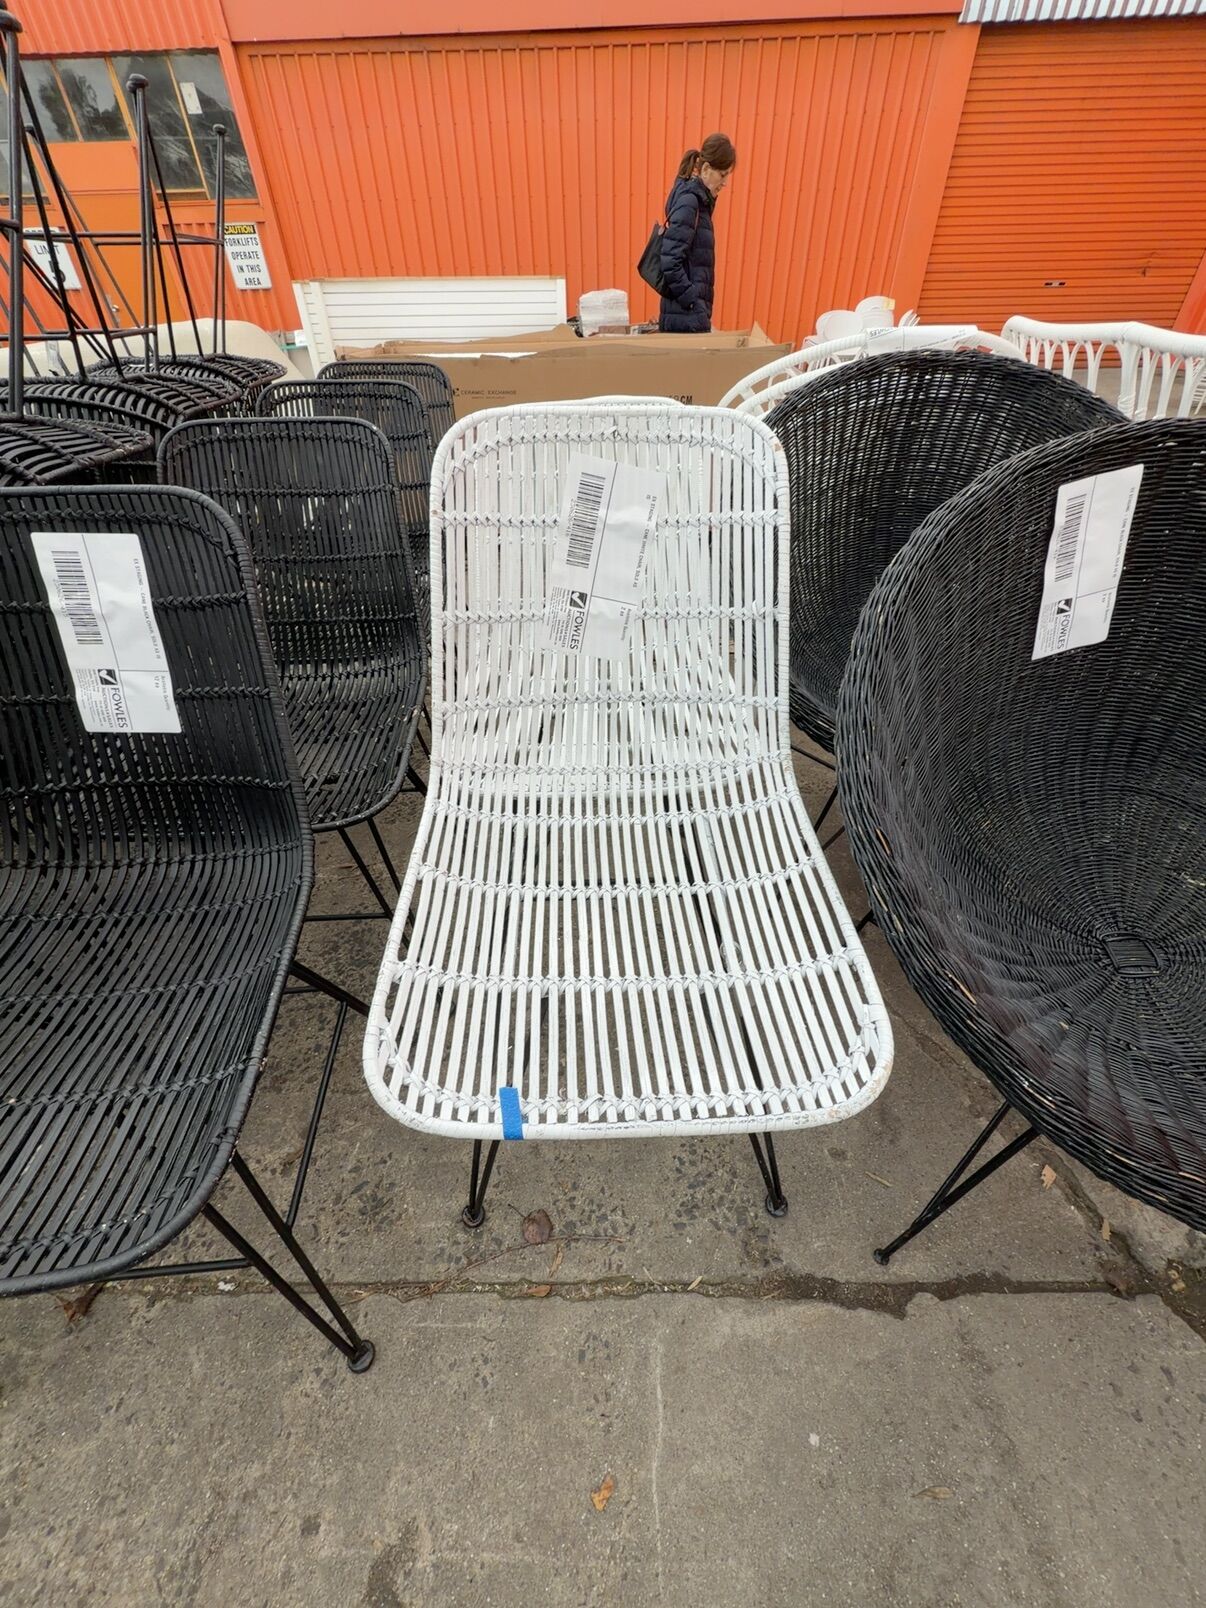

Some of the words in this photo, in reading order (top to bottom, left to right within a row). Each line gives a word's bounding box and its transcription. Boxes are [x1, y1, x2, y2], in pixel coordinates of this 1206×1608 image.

[225, 225, 254, 234] CAUTION
[225, 237, 258, 247] FORKLIFTS
[231, 251, 260, 260] OPERATE
[237, 265, 245, 273] IN
[246, 264, 261, 273] THIS
[245, 277, 262, 286] AREA
[569, 610, 585, 650] FOWLES
[1057, 614, 1071, 649] FOWLES
[110, 687, 129, 728] FOWLES
